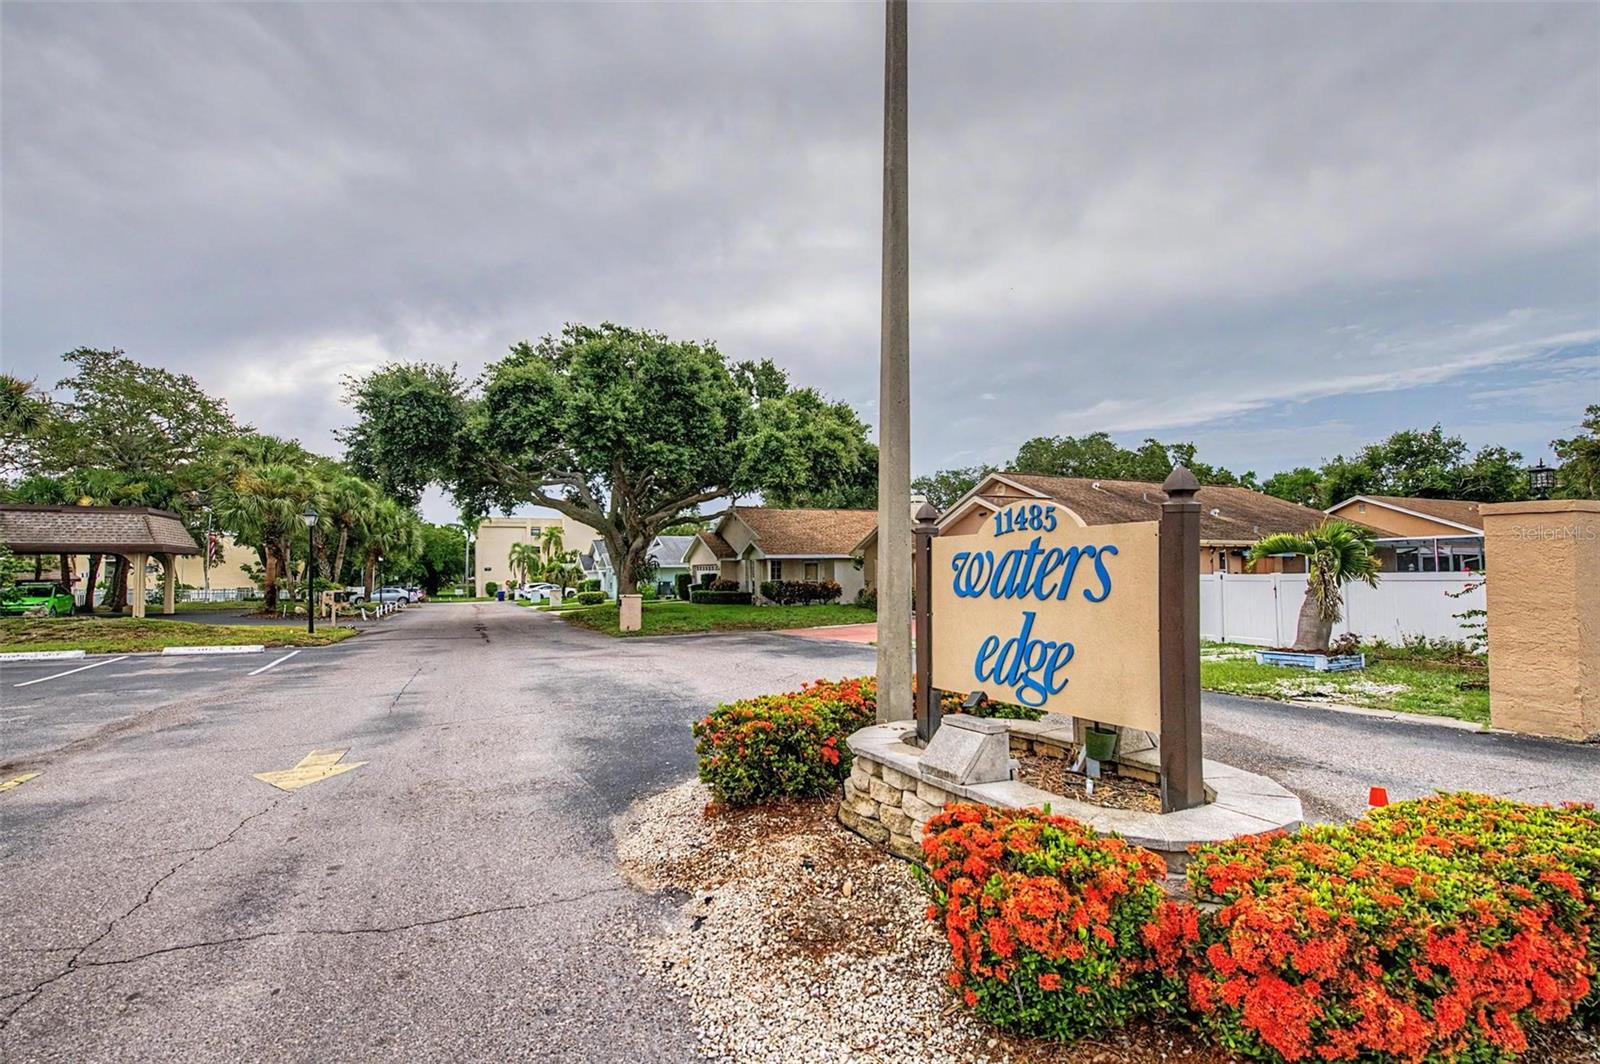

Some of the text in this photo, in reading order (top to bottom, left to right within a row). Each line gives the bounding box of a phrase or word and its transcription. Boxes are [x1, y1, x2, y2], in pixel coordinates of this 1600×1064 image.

[994, 503, 1057, 537] 11485
[951, 536, 1119, 603] waters
[974, 611, 1075, 707] edge
